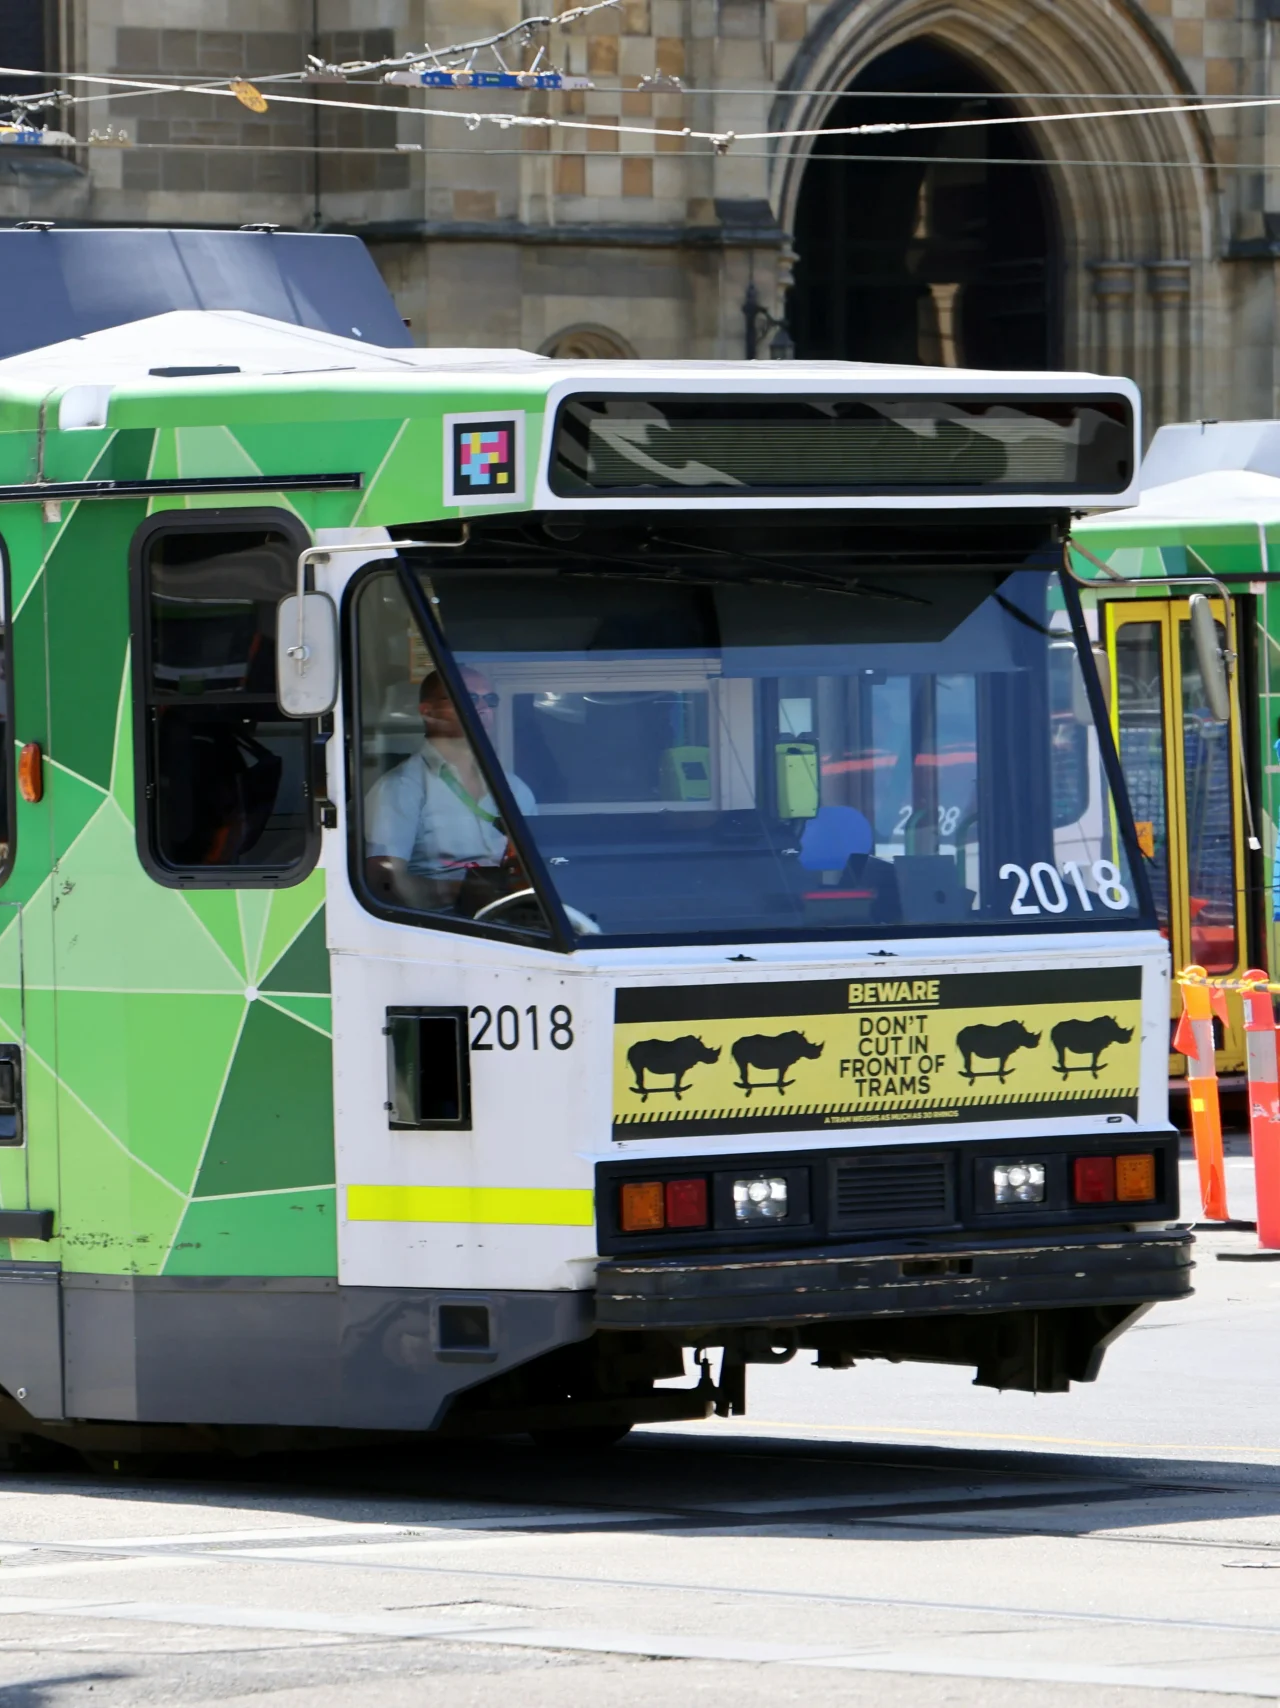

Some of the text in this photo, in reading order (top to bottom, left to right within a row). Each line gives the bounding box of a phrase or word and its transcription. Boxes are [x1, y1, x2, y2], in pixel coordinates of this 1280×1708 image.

[999, 859, 1130, 916] 2018
[848, 980, 940, 1004] BEWARE
[470, 1004, 574, 1051] 2018
[859, 1014, 929, 1036] DON'T
[858, 1035, 929, 1057] CUT IN
[840, 1054, 946, 1078] FRONT OF
[854, 1075, 931, 1098] TRAMS
